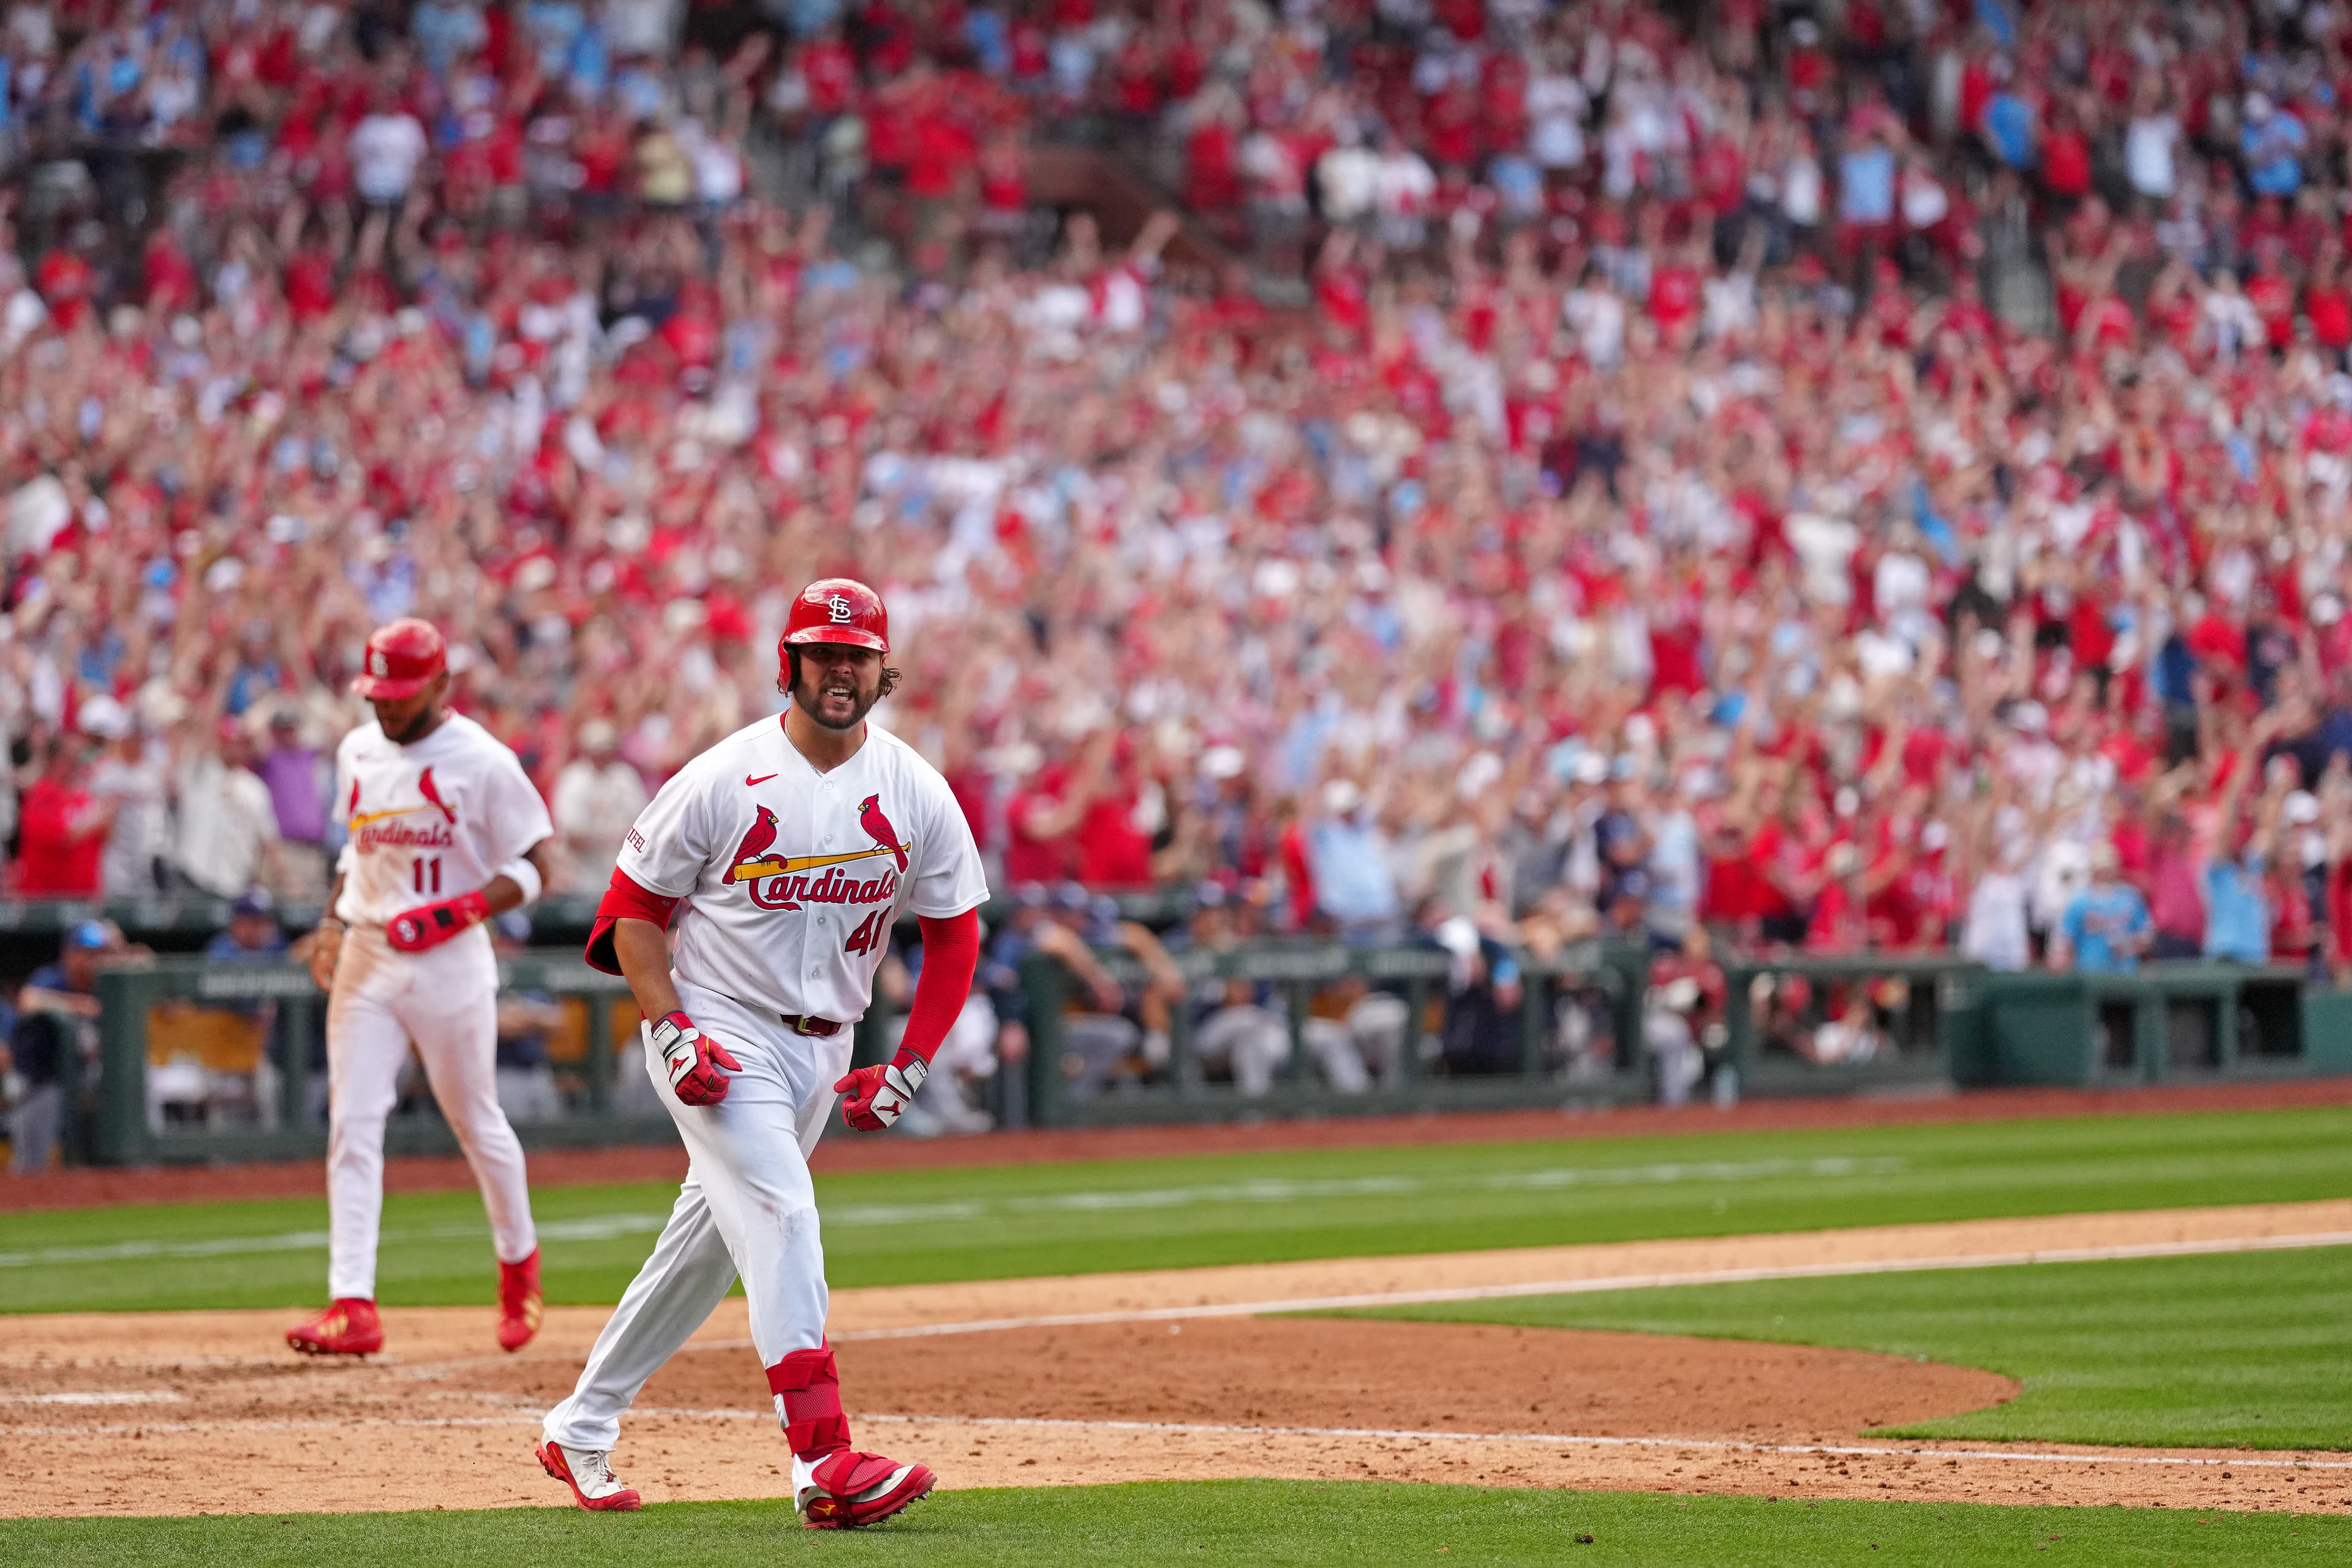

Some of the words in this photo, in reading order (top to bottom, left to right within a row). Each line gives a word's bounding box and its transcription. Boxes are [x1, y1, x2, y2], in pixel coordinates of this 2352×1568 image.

[627, 827, 646, 853] IFEL
[413, 857, 441, 894] 11
[748, 855, 895, 911] Cardinals
[845, 905, 892, 957] 41
